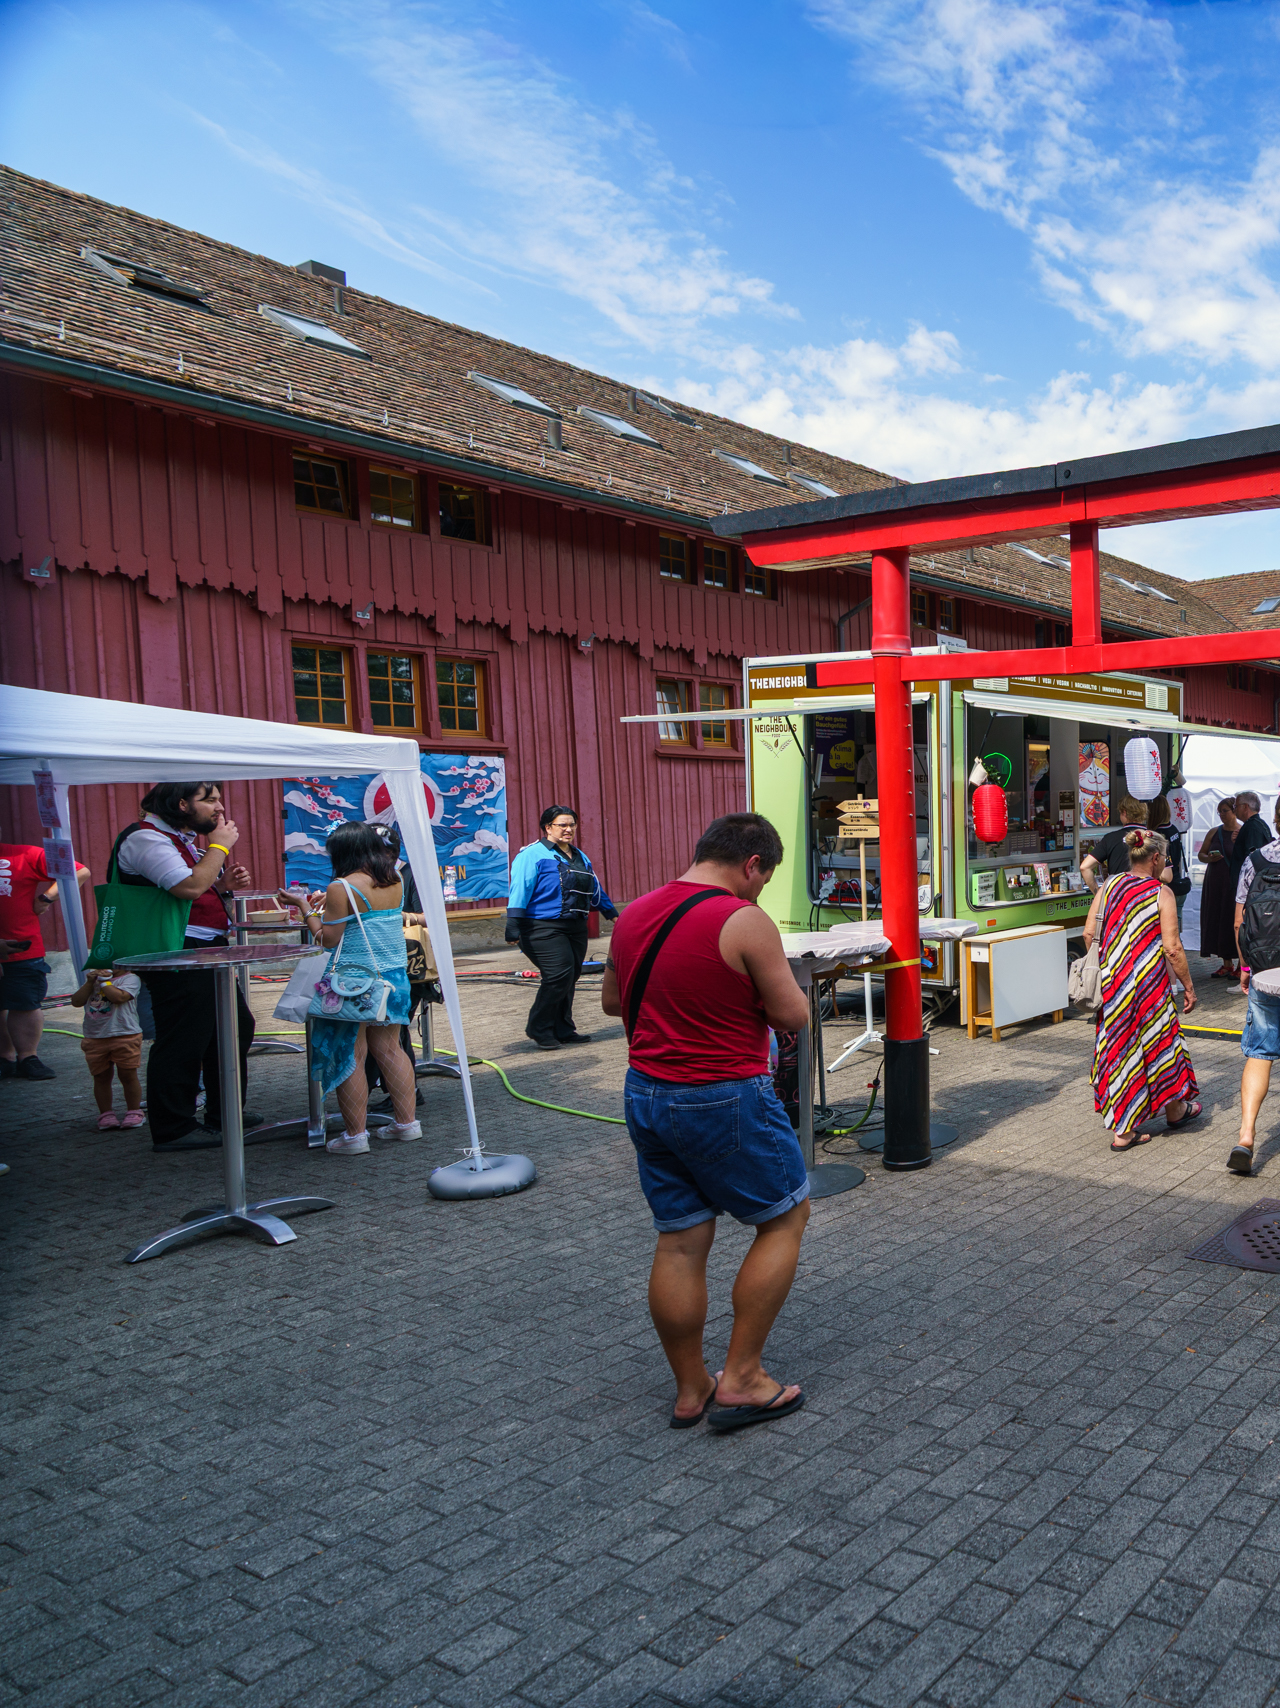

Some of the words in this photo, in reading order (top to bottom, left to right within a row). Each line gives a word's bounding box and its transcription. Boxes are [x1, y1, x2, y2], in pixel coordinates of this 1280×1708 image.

[1056, 679, 1069, 687] VEGAN
[1074, 682, 1097, 691] NACHHALTIG
[1102, 686, 1122, 694] INNOVATION
[833, 745, 852, 753] Klima
[99, 906, 110, 942] POLITECNICO
[106, 918, 115, 942] MILANO
